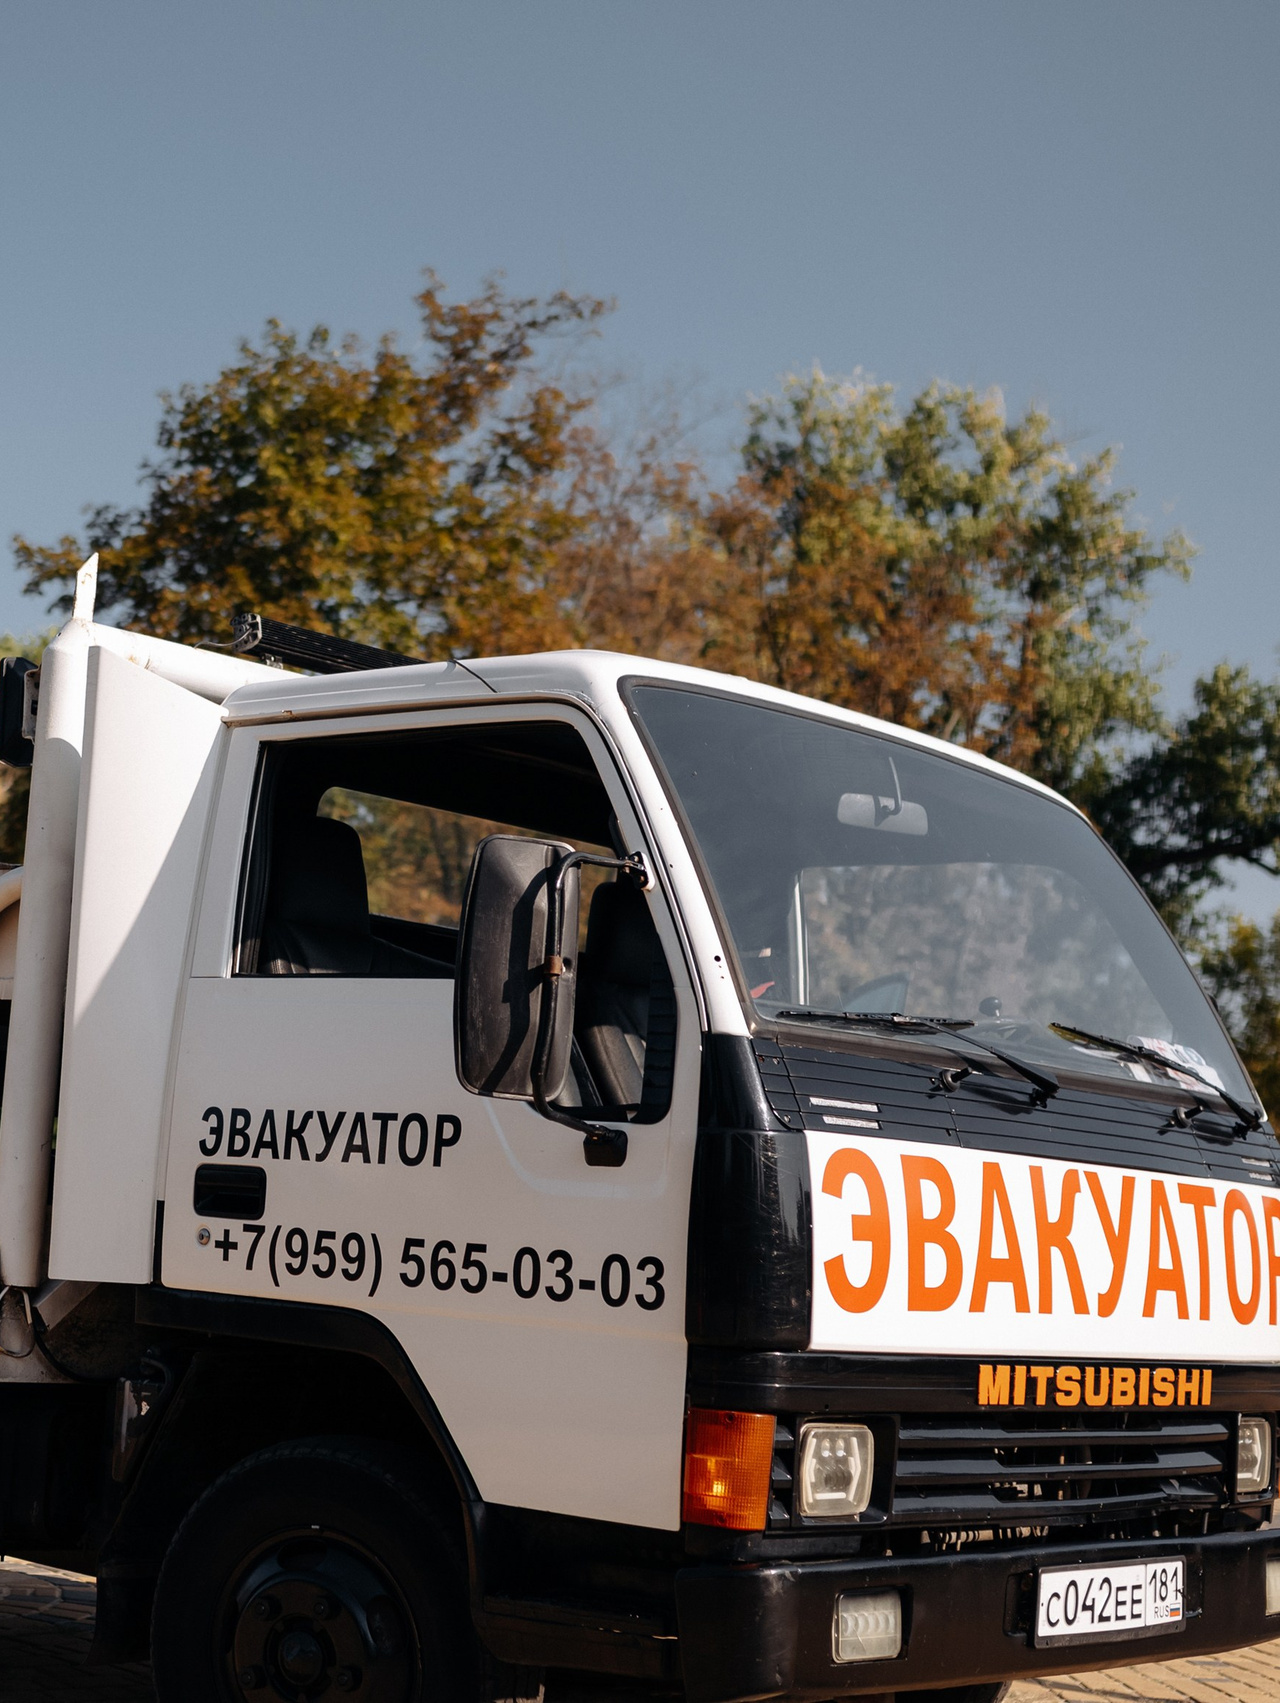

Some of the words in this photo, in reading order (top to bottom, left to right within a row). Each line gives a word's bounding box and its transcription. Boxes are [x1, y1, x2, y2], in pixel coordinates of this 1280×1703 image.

[198, 1106, 462, 1167] ЭВАКУАТОР
[214, 1223, 383, 1297] +7(959)
[399, 1237, 665, 1311] 565-03-03
[977, 1364, 1212, 1406] MITSUBISHI
[1149, 1566, 1179, 1603] 181
[1153, 1605, 1170, 1619] RUS
